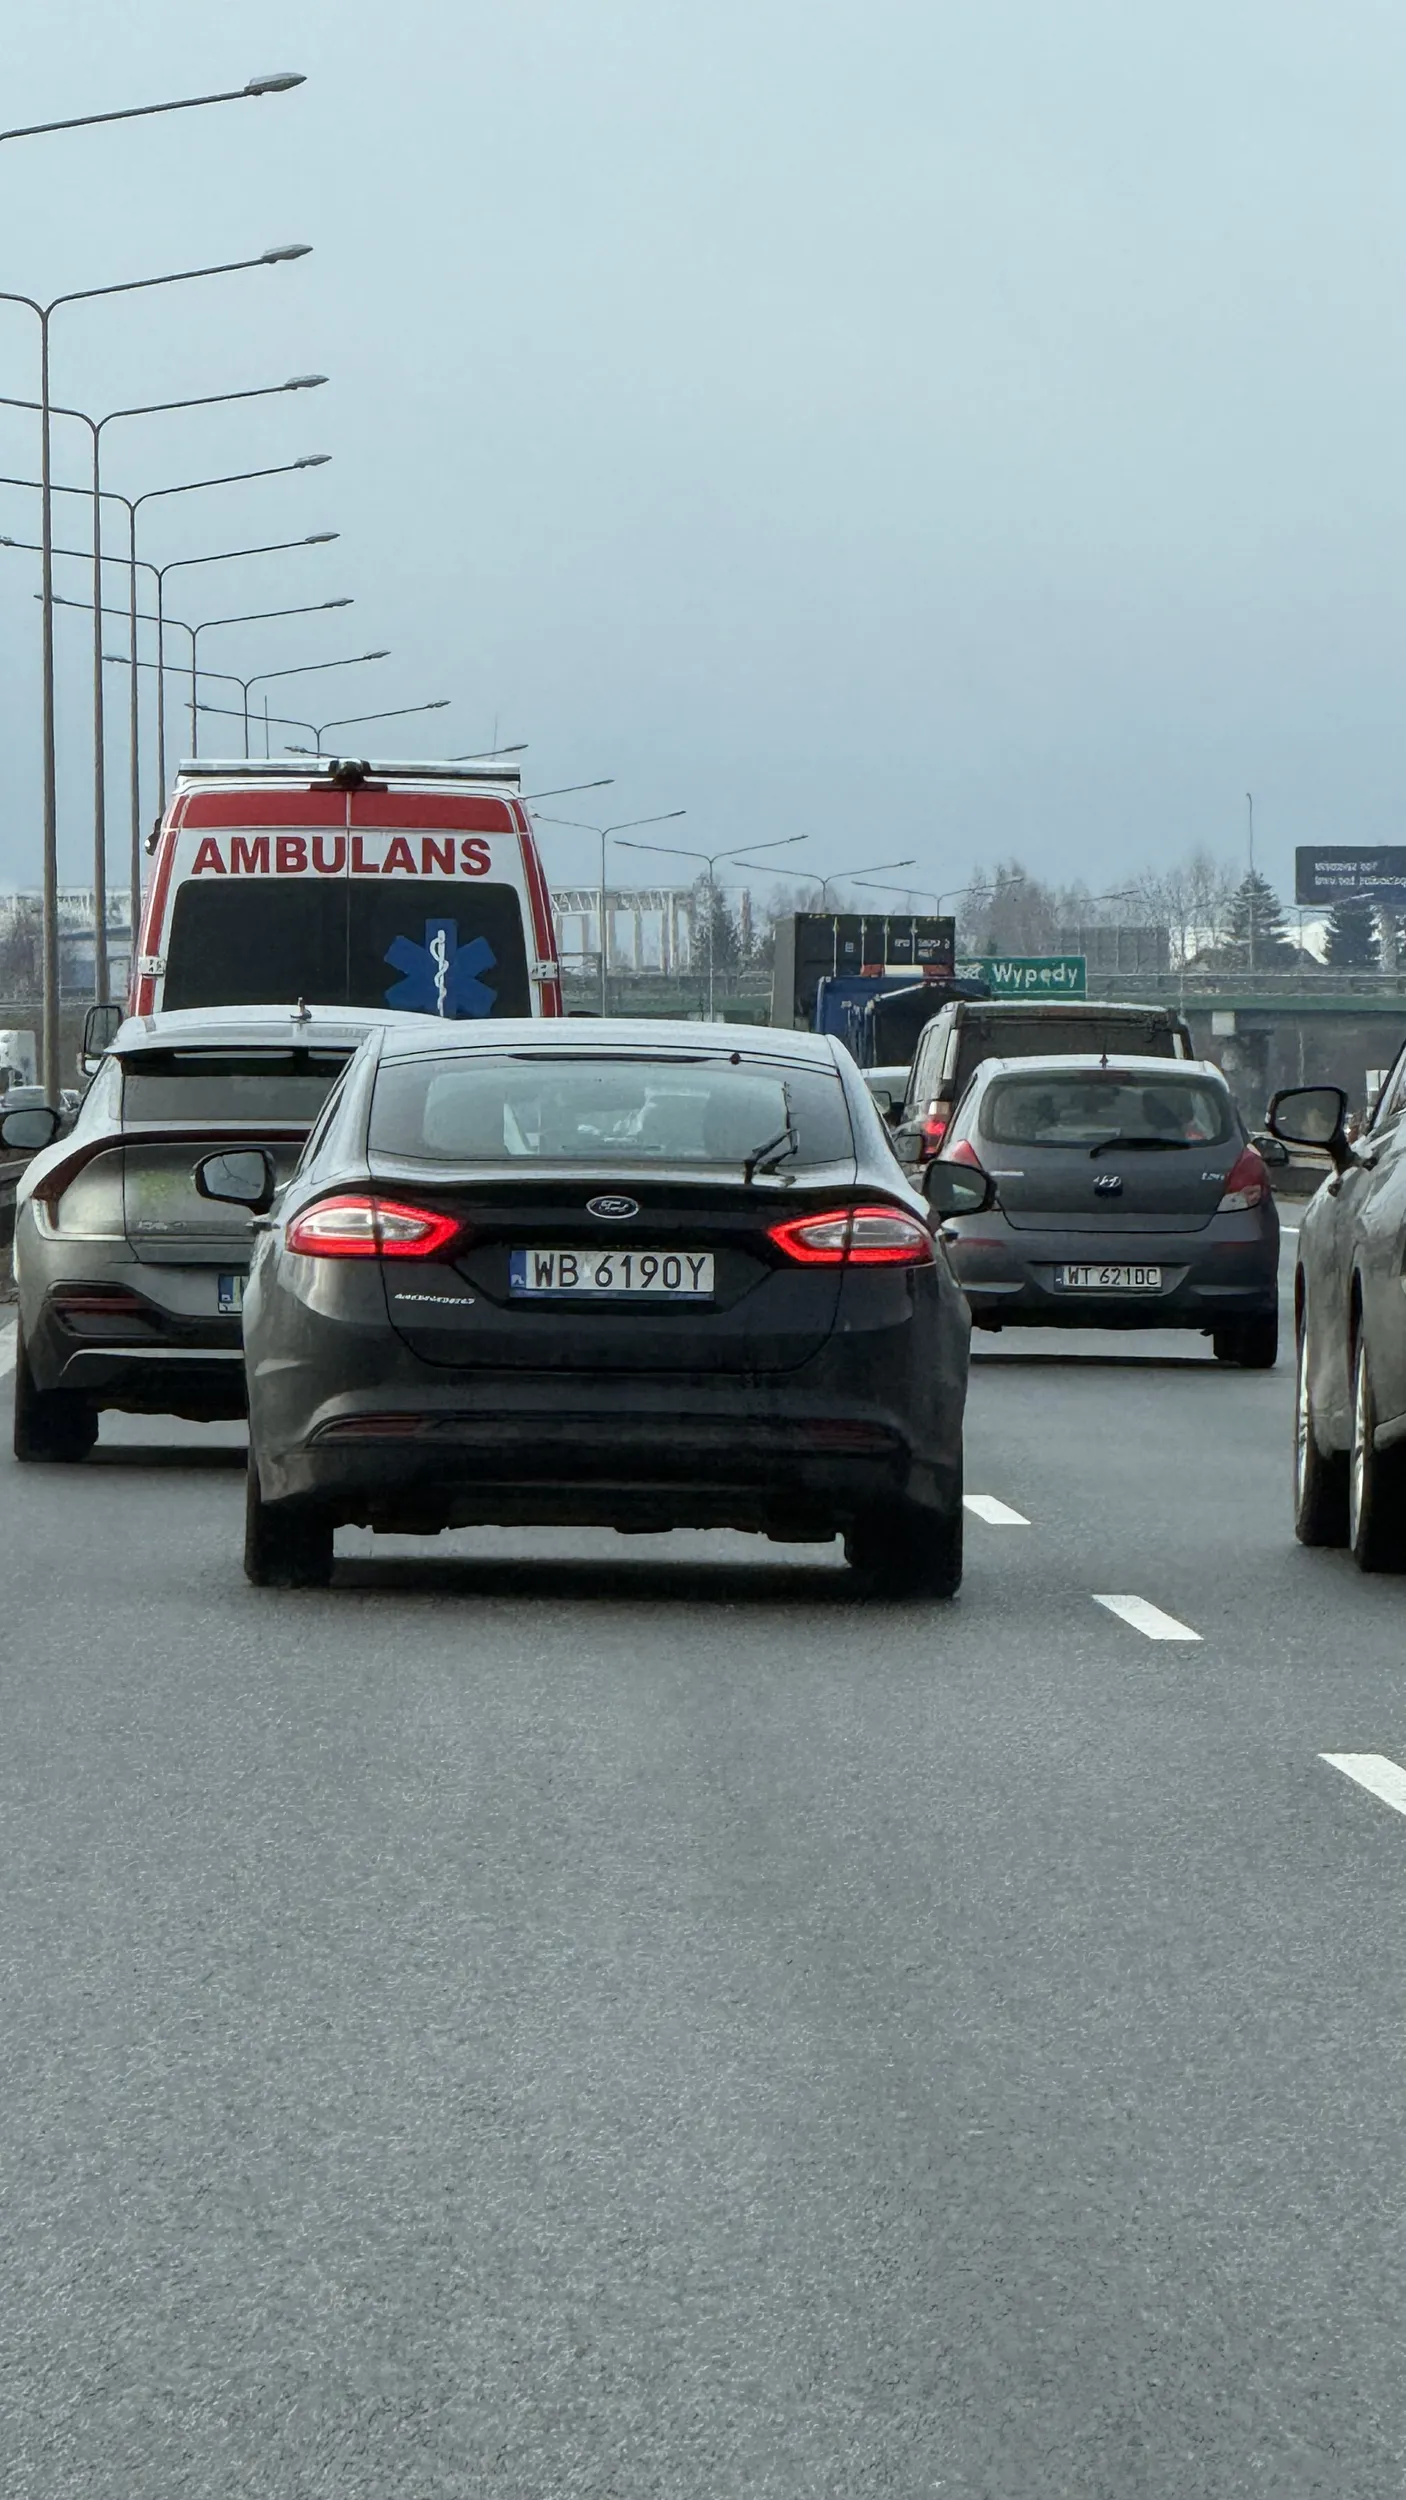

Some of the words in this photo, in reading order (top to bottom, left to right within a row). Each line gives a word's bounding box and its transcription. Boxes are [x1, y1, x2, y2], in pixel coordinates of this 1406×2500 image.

[191, 836, 492, 876] AMBULANS
[992, 963, 1078, 988] Wypędy
[534, 1252, 579, 1288] WB
[595, 1254, 706, 1290] 6190Y
[1068, 1266, 1091, 1284] WT
[1100, 1267, 1158, 1285] 6210C
